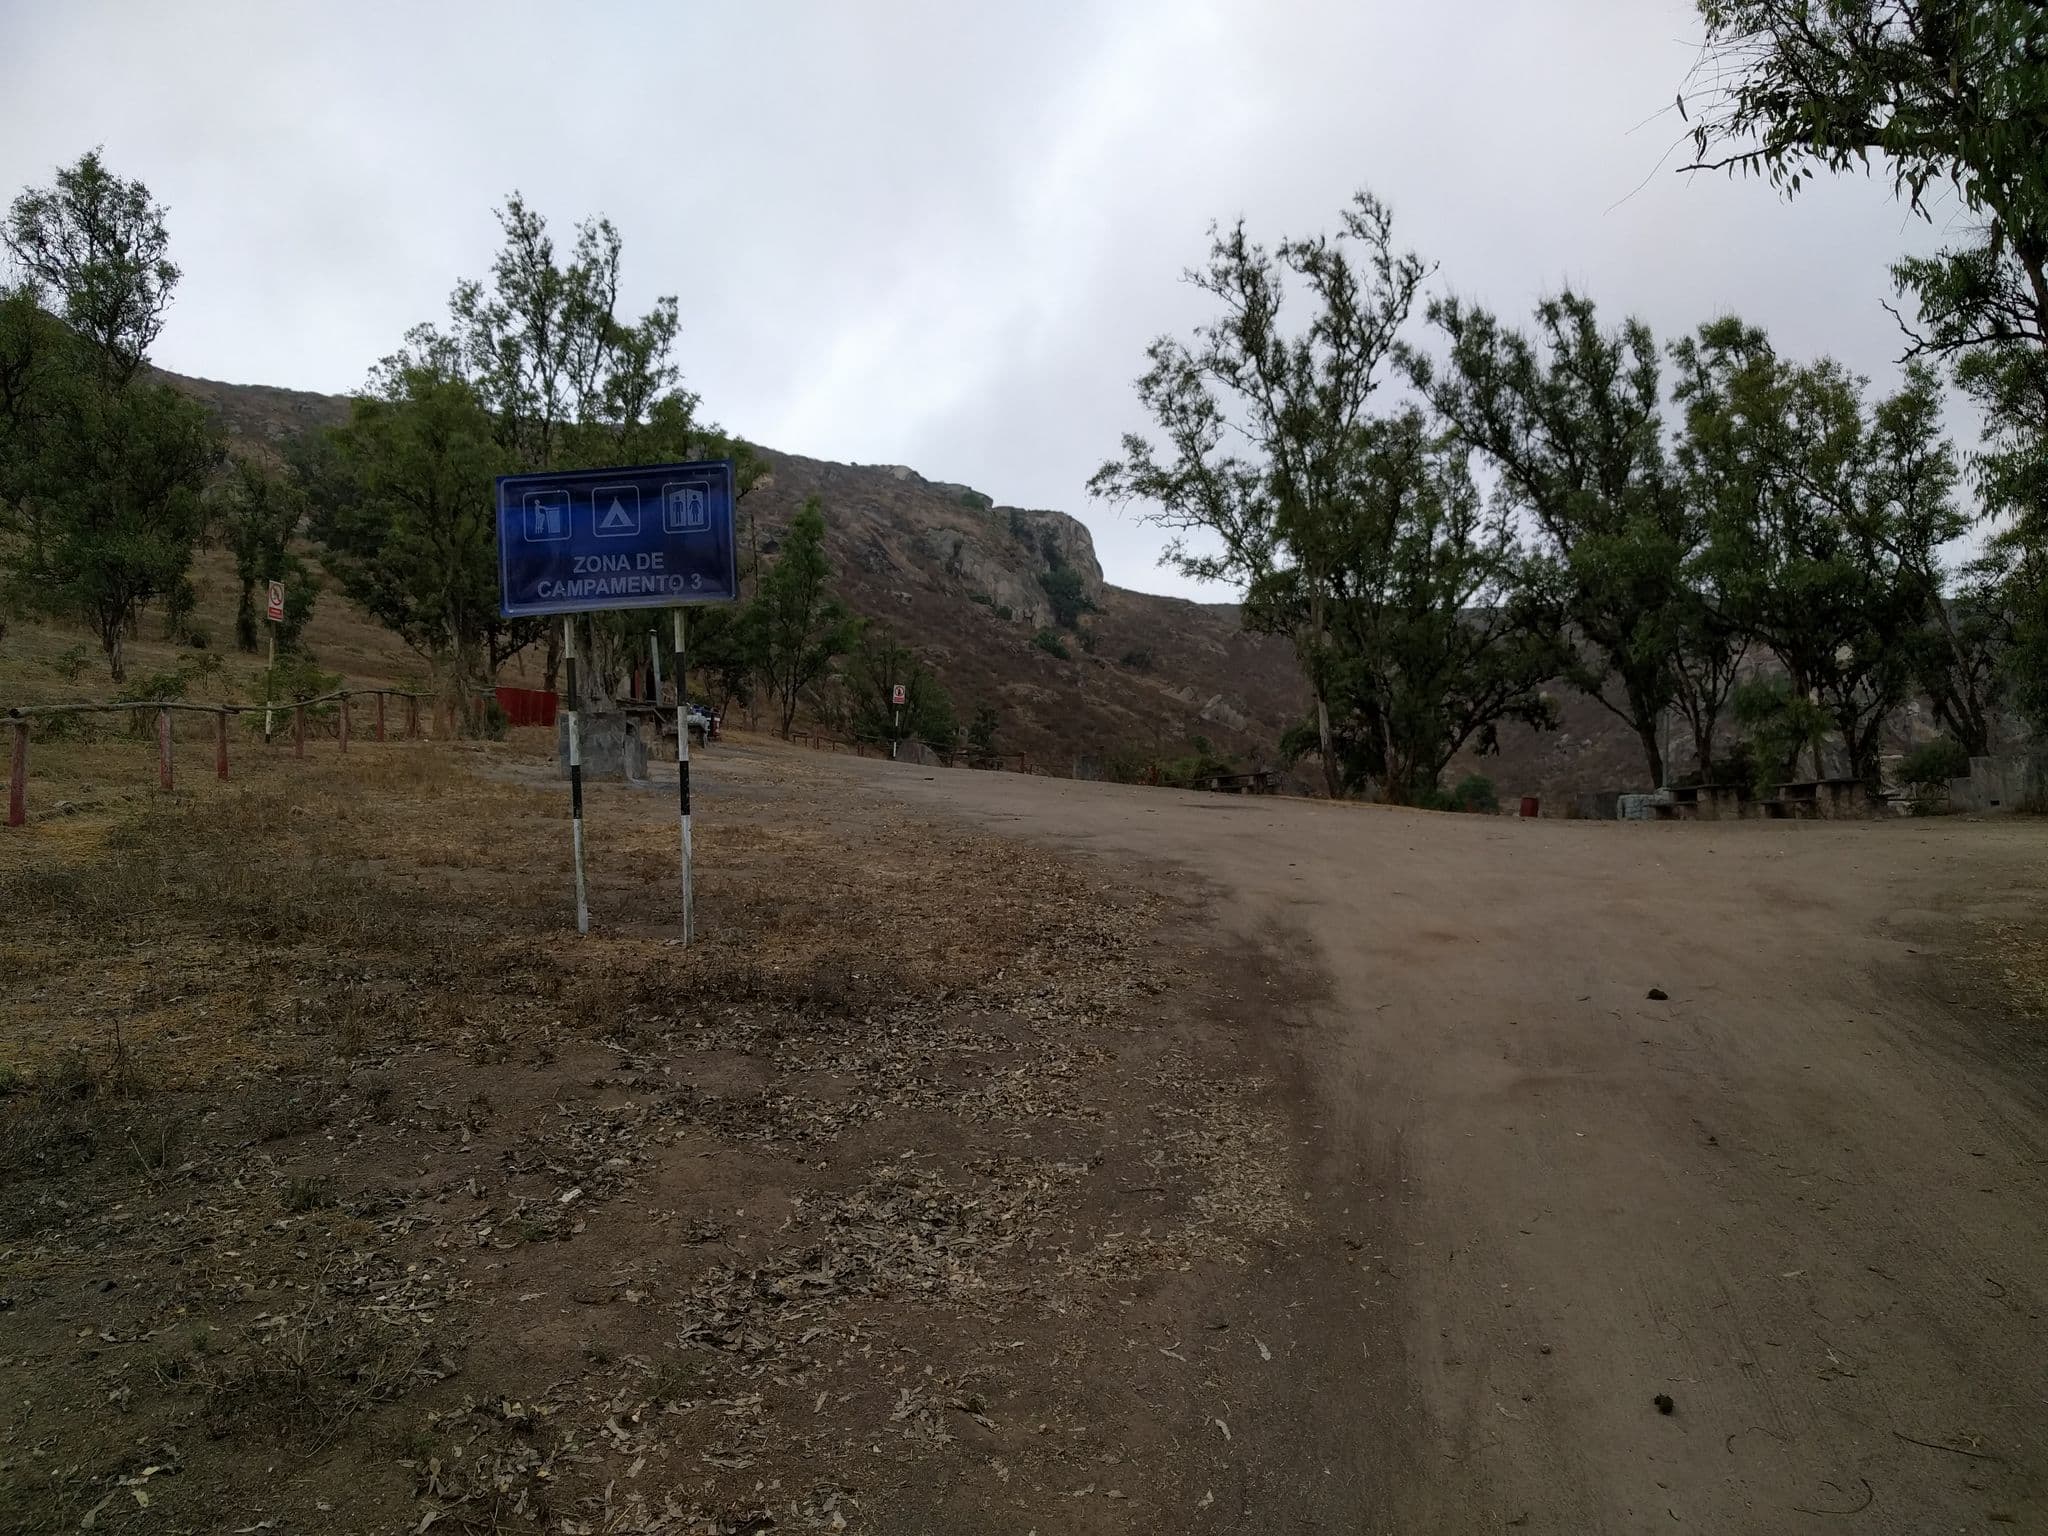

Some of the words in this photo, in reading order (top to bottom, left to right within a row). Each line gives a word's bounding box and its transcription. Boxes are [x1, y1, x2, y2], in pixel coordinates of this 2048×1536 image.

[573, 554, 631, 573] ZONA
[637, 552, 664, 570] DE
[537, 575, 684, 598] CAMPAMENTO
[691, 573, 703, 590] 3
